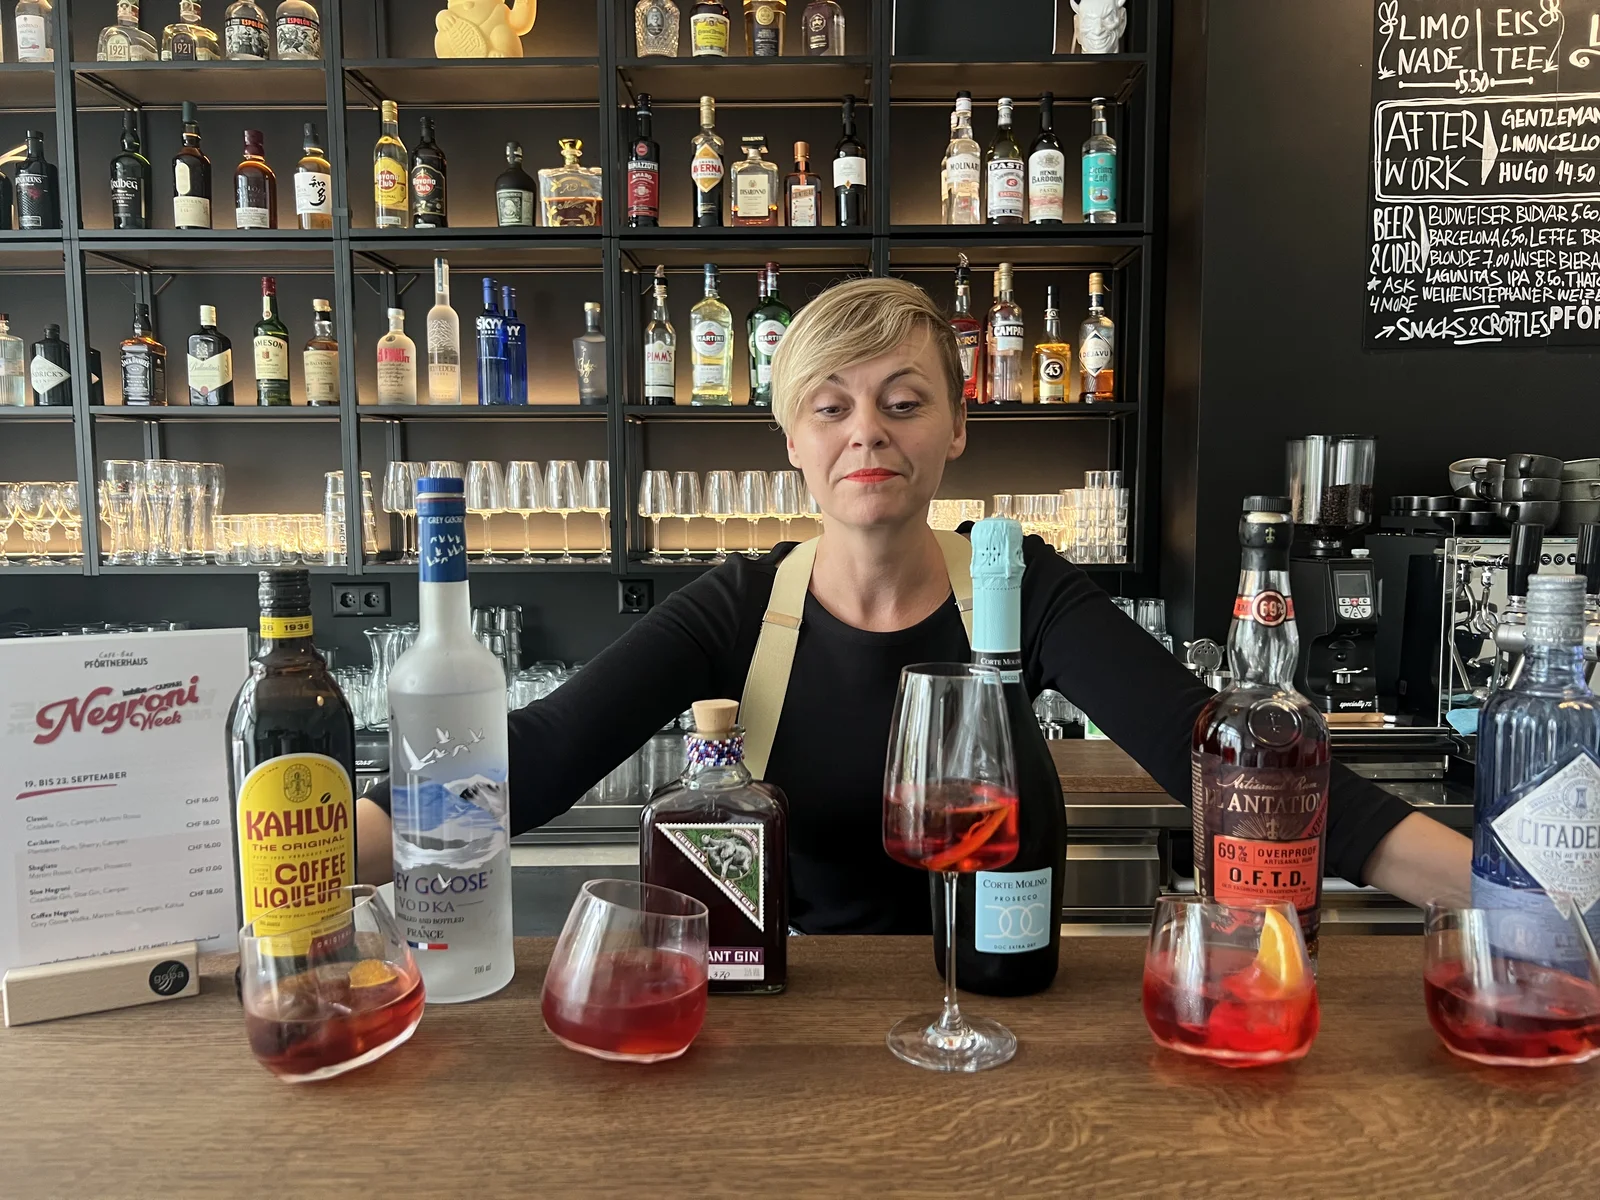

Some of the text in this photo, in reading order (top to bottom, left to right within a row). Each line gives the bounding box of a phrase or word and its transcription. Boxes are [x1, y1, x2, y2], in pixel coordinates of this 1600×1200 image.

[1399, 13, 1469, 40] LIMO
[1497, 8, 1538, 36] EIS
[109, 44, 127, 56] 1921
[174, 43, 191, 54] 1921
[1398, 46, 1464, 75] NADE
[1490, 46, 1546, 74] TEE
[1458, 69, 1490, 94] 5.50
[1385, 109, 1484, 152] AFTER
[1032, 176, 1062, 184] BARDOUIN
[1385, 155, 1469, 190] WORK
[1499, 160, 1596, 186] HUGO 14.50
[1373, 205, 1416, 242] BEER
[1428, 205, 1514, 226] BUDWEISER
[1516, 205, 1569, 224] BUDVAR
[1429, 228, 1500, 248] BARCELONA
[1530, 226, 1577, 248] LEFFE
[1430, 250, 1480, 268] BLONDE
[1514, 248, 1557, 267] UNSER
[1425, 268, 1503, 287] LAGUNITAS
[1507, 269, 1530, 286] IPA
[1421, 285, 1556, 304] WEIHENSTEPHANER
[477, 317, 503, 330] SKYY
[507, 325, 520, 336] YY
[1395, 317, 1467, 341] SNACKS
[647, 351, 673, 362] PIMM'S
[1045, 365, 1061, 375] 43
[284, 622, 309, 631] 1936
[84, 658, 148, 668] PFÖRTNERHAUS
[33, 675, 200, 744] Negroni
[1339, 700, 1364, 709] specialty
[130, 707, 182, 731] Week
[25, 772, 127, 788] 19. BIS 23. SEPTEMBER
[245, 792, 348, 841] KAHLÚA
[281, 834, 345, 851] ORIGINAL
[1517, 818, 1600, 849] CITADE
[1218, 842, 1235, 860] 69
[1257, 846, 1317, 859] OVERPROOF
[275, 852, 346, 885] COFFEE
[1229, 867, 1306, 887] O.F.T.D.
[415, 872, 489, 895] GOOSE
[983, 877, 1047, 889] CORTE MOLINO
[254, 877, 342, 909] LIQUEUR
[994, 893, 1038, 902] PROSECCO
[399, 896, 455, 913] VODKA
[741, 896, 756, 912] GIN
[407, 927, 444, 939] FRANCE
[734, 951, 759, 962] GIN
